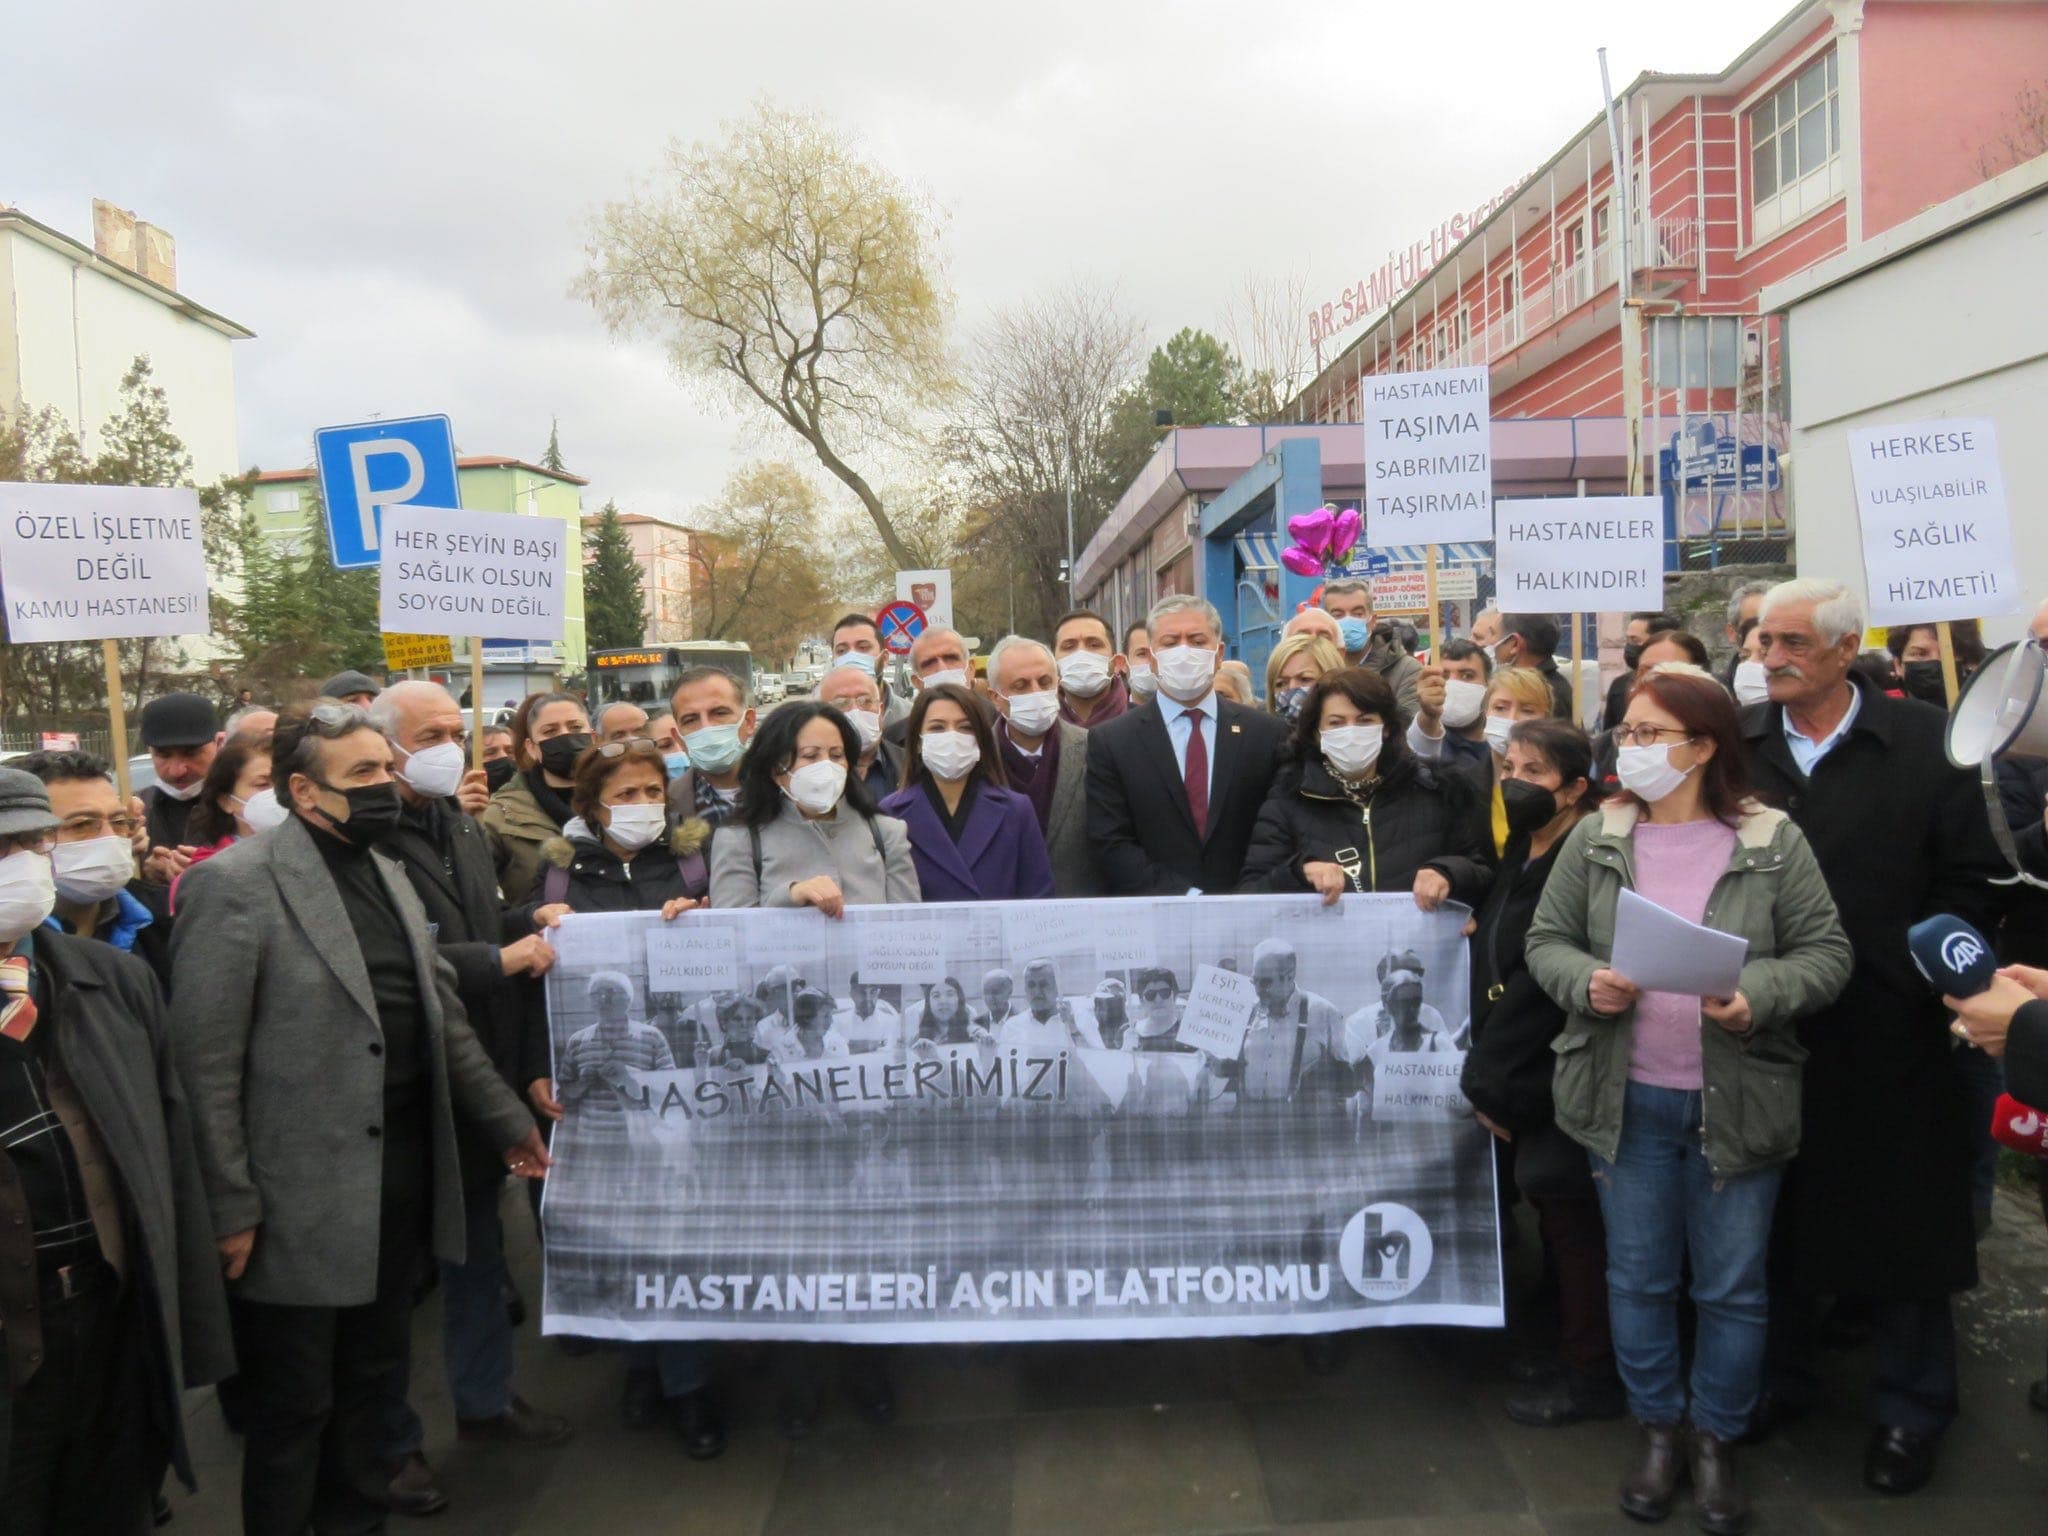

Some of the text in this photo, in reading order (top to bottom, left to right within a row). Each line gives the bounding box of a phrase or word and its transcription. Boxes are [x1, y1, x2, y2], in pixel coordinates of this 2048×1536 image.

[1374, 374, 1484, 402] HASTANEMİ
[1379, 411, 1480, 442] TAŞIMA
[1870, 431, 1975, 460] HERKESE
[1375, 453, 1487, 479] SABRIMIZI
[349, 438, 425, 551] P
[1377, 490, 1486, 518] TAŞIRMA!
[1870, 478, 1988, 505] ULAŞILABİLİR
[15, 510, 193, 545] ÖZEL İŞLETME
[1509, 520, 1655, 542] HASTANELER
[1893, 521, 1978, 549] SAĞLIK
[395, 530, 557, 563] HER ŞEYİN BAŞI
[76, 552, 152, 581] DEĞİL
[398, 560, 553, 588] SAĞLIK OLSUN
[1516, 569, 1646, 590] HALKINDIR!
[1888, 570, 1998, 602] HİZMETİ!
[15, 593, 199, 620] KAMU HASTANESİ!
[398, 592, 551, 616] SOYGUN DEĞİL.
[1384, 1064, 1460, 1077] HASTANELE
[635, 1264, 1331, 1315] HASTANELERİ AÇIN PLATFORMU
